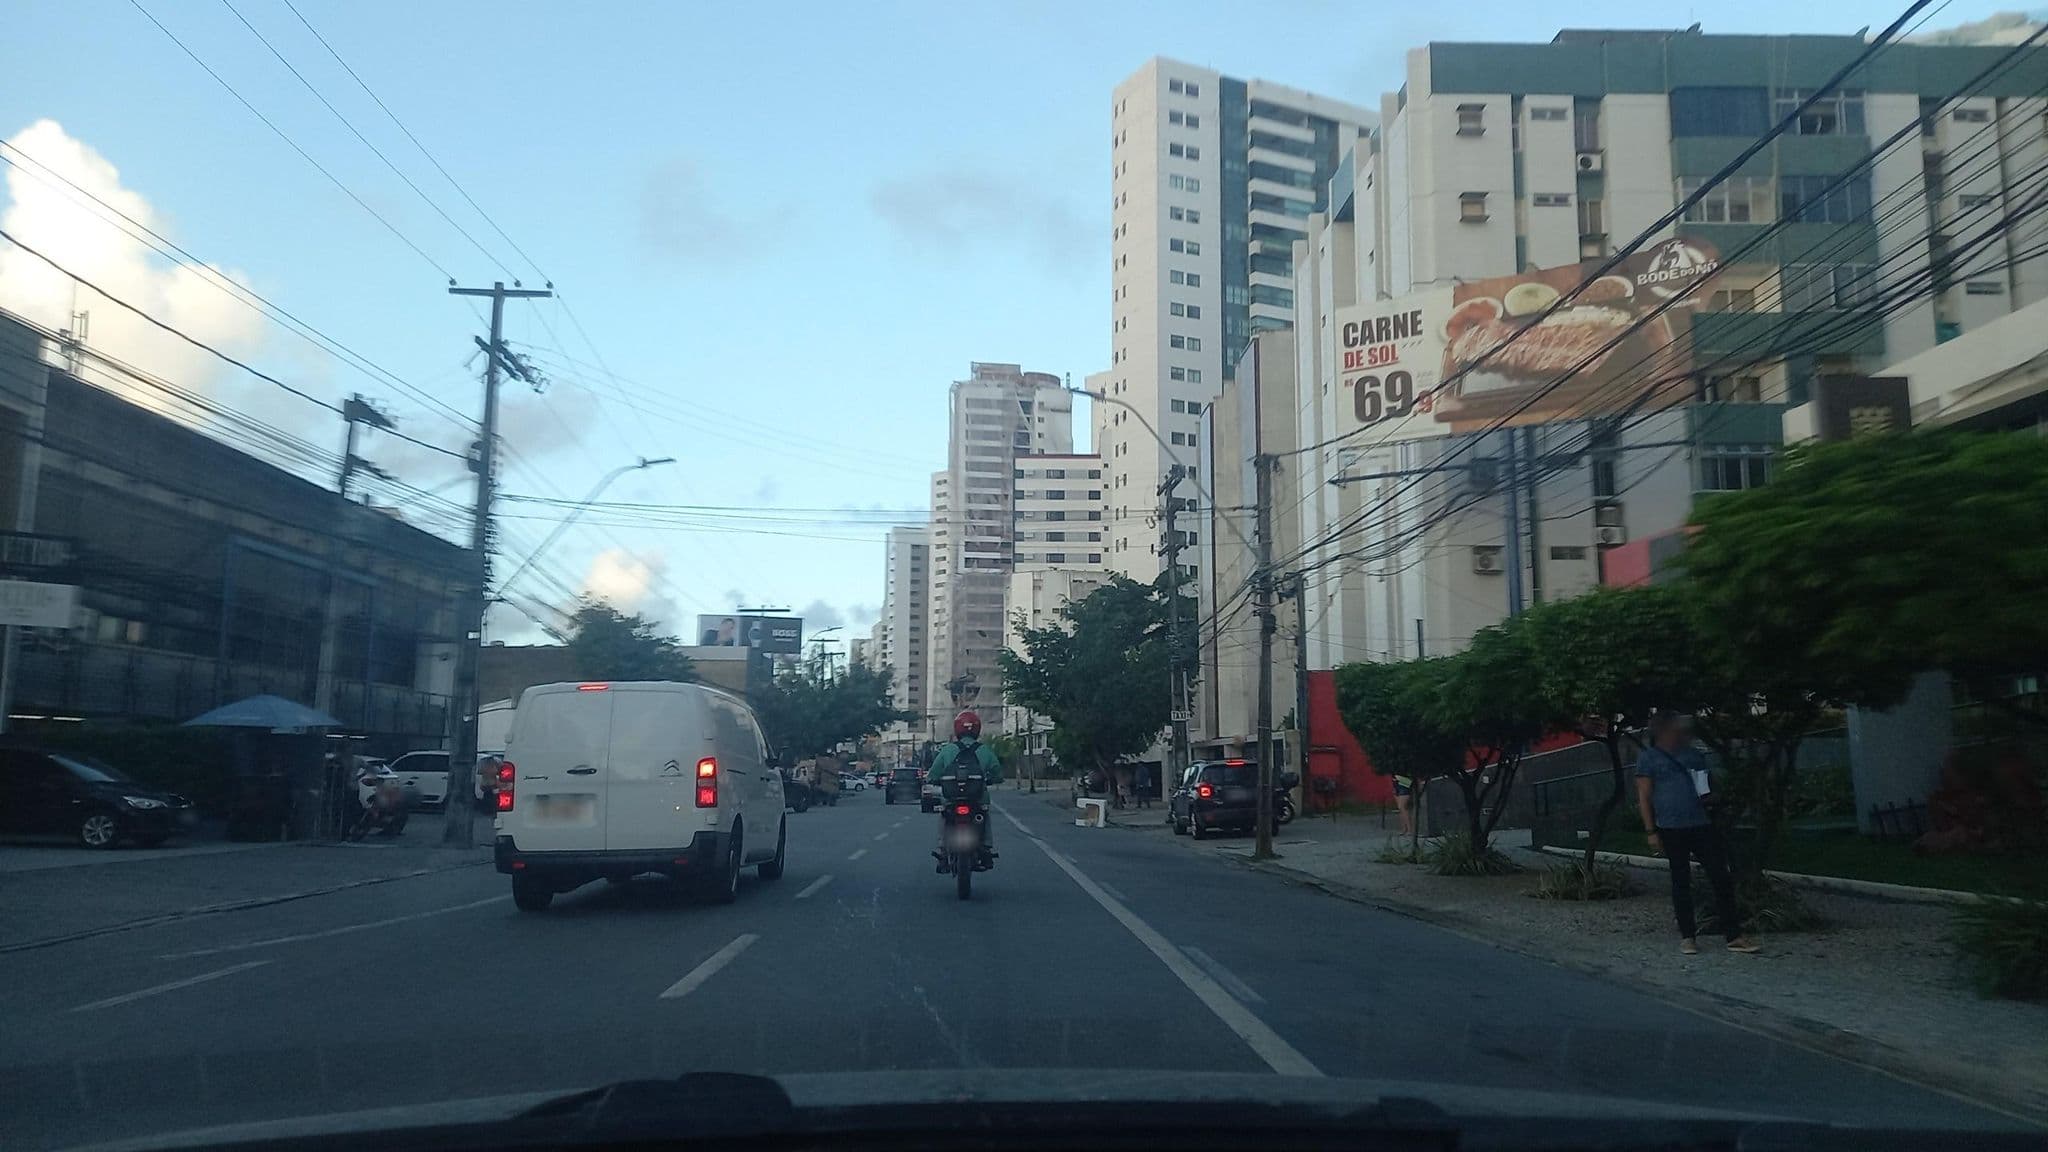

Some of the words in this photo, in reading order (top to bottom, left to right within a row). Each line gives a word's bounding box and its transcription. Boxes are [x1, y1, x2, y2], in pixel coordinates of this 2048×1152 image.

[1637, 268, 1680, 285] BODE
[1680, 268, 1695, 277] DO
[1343, 309, 1423, 348] CARNE
[1344, 349, 1364, 369] DE
[1367, 343, 1399, 365] SOL
[1354, 370, 1413, 423] 69
